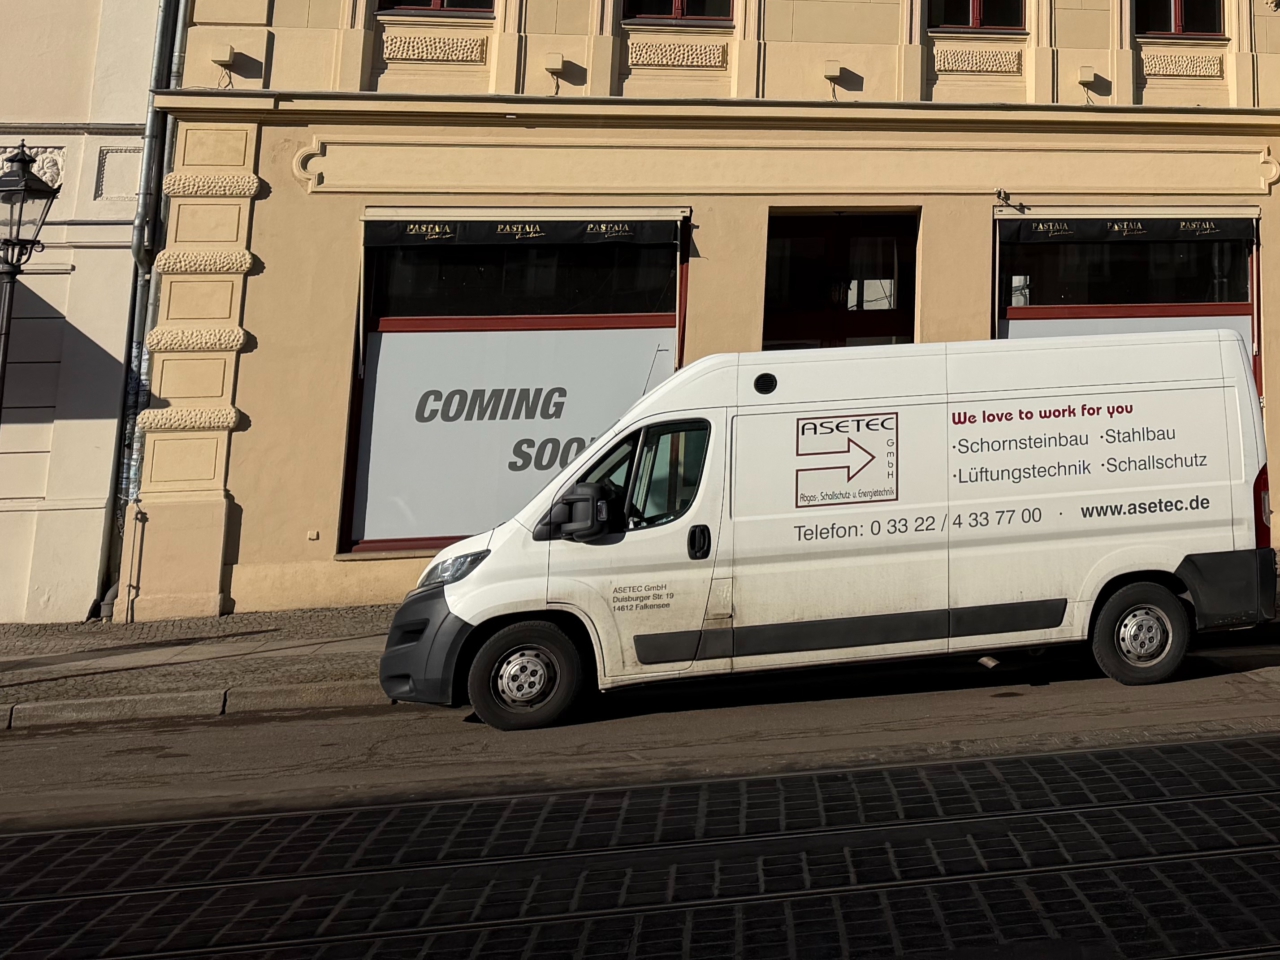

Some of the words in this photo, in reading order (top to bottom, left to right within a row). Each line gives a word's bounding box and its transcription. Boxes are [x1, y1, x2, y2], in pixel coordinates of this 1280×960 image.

[406, 224, 451, 233] PASTAIA
[497, 224, 541, 232] PASTAIA
[587, 223, 629, 231] PASTAIA
[1032, 222, 1068, 230] PASTAIA
[1107, 221, 1142, 230] PASTAIA
[1180, 221, 1215, 229] PASTAIA
[415, 387, 567, 423] COMING
[951, 412, 977, 426] We
[982, 410, 1013, 424] love
[1018, 407, 1034, 421] to
[1039, 405, 1076, 420] work
[1080, 404, 1102, 417] for
[1107, 404, 1133, 418] you
[801, 417, 894, 436] ASETEC
[957, 432, 1089, 454] Schornsteinbau
[1105, 427, 1176, 444] Stahlbau
[508, 437, 596, 472] SOO
[958, 460, 1091, 484] Lüftungstechnik
[1106, 453, 1208, 473] Schallschutz
[858, 487, 895, 500] Energietechnik
[1081, 494, 1210, 519] www.asetec.de
[794, 523, 864, 542] Telefon:
[870, 520, 881, 536] 0
[887, 518, 908, 535] 33
[914, 515, 936, 532] 22
[952, 514, 963, 529] 4
[968, 511, 990, 527] 33
[995, 509, 1016, 525] 77
[1021, 507, 1042, 523] 00
[613, 586, 643, 594] ASETEC
[644, 584, 667, 592] GmbH
[613, 595, 651, 603] Duisburger
[613, 604, 634, 612] 14612
[635, 603, 670, 611] Falkensee
